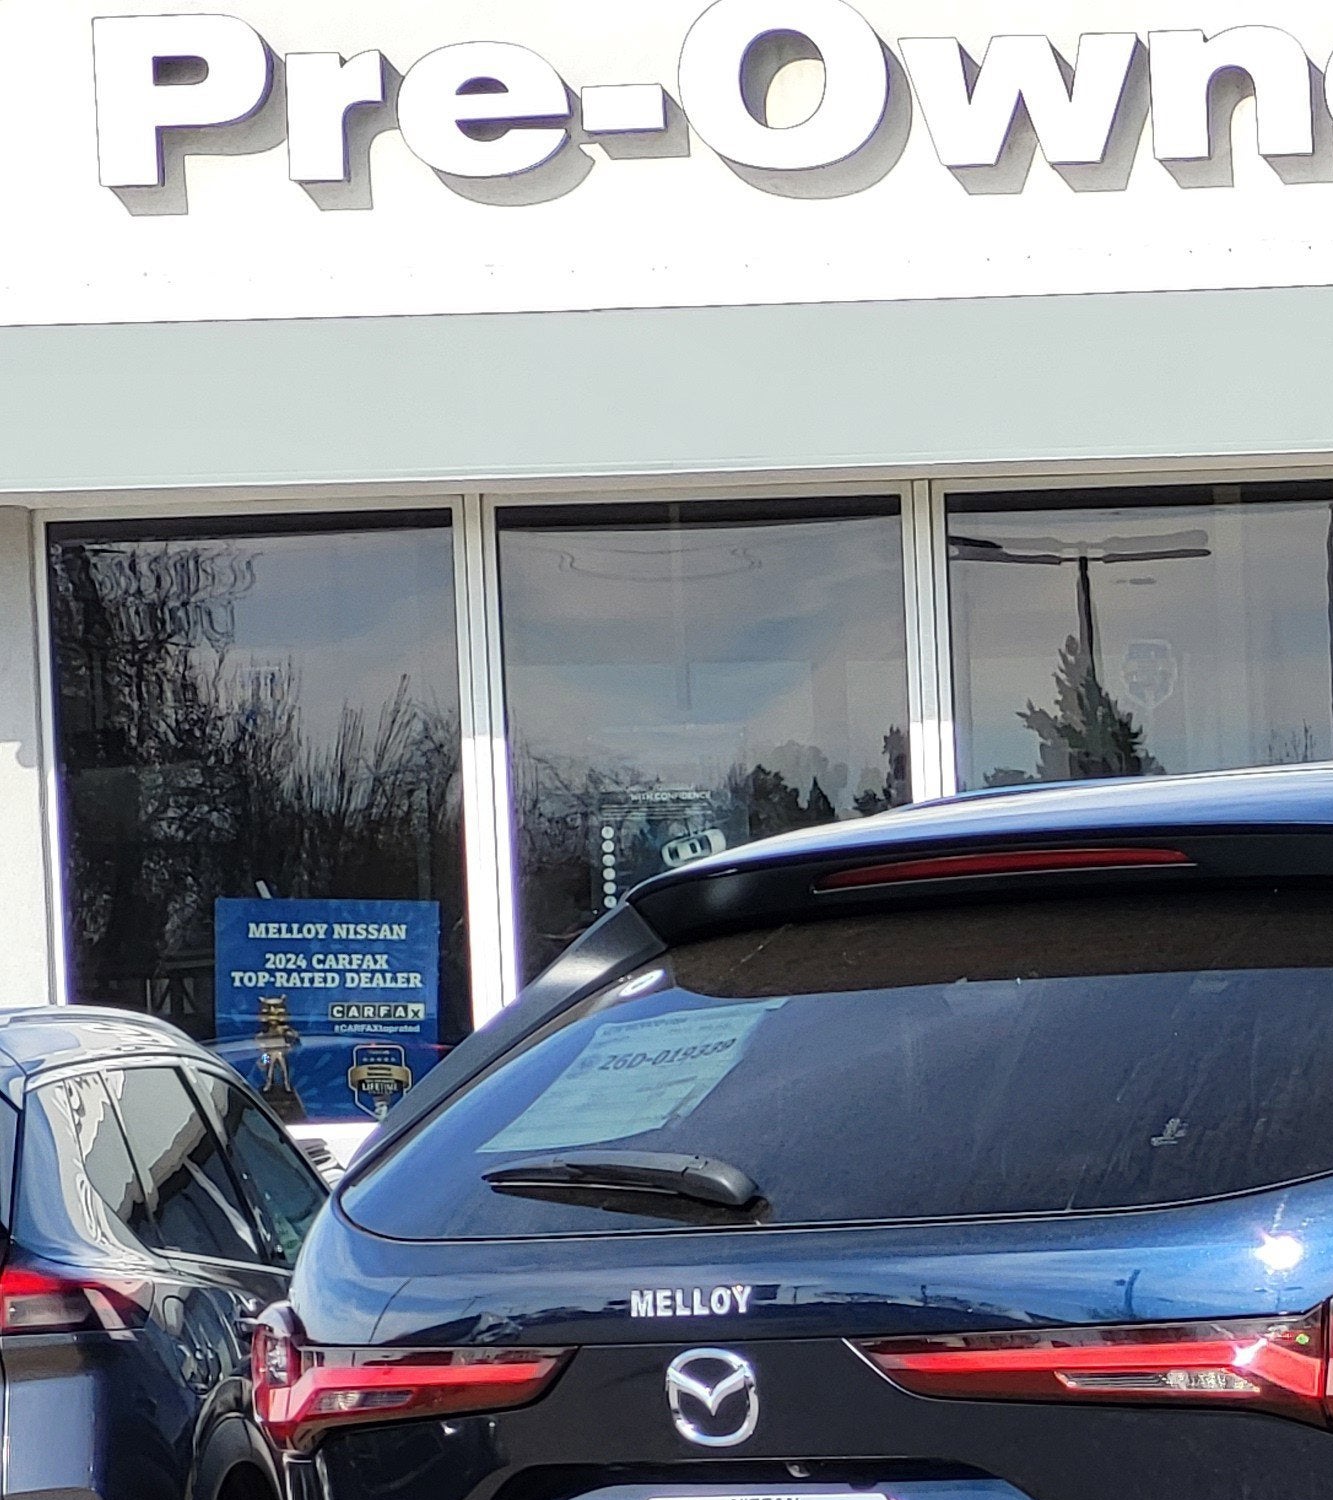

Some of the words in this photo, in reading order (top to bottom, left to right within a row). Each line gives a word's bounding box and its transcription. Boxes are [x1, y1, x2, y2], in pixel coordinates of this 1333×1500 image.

[248, 923, 326, 940] MELLOY
[333, 924, 407, 940] NISSAN
[265, 953, 306, 969] 2024
[312, 954, 388, 969] CARFAX
[231, 971, 339, 988] TOP-RATED
[345, 973, 422, 988] DEALER
[332, 1005, 423, 1019] CARFAX
[630, 1285, 752, 1318] MELLOY
